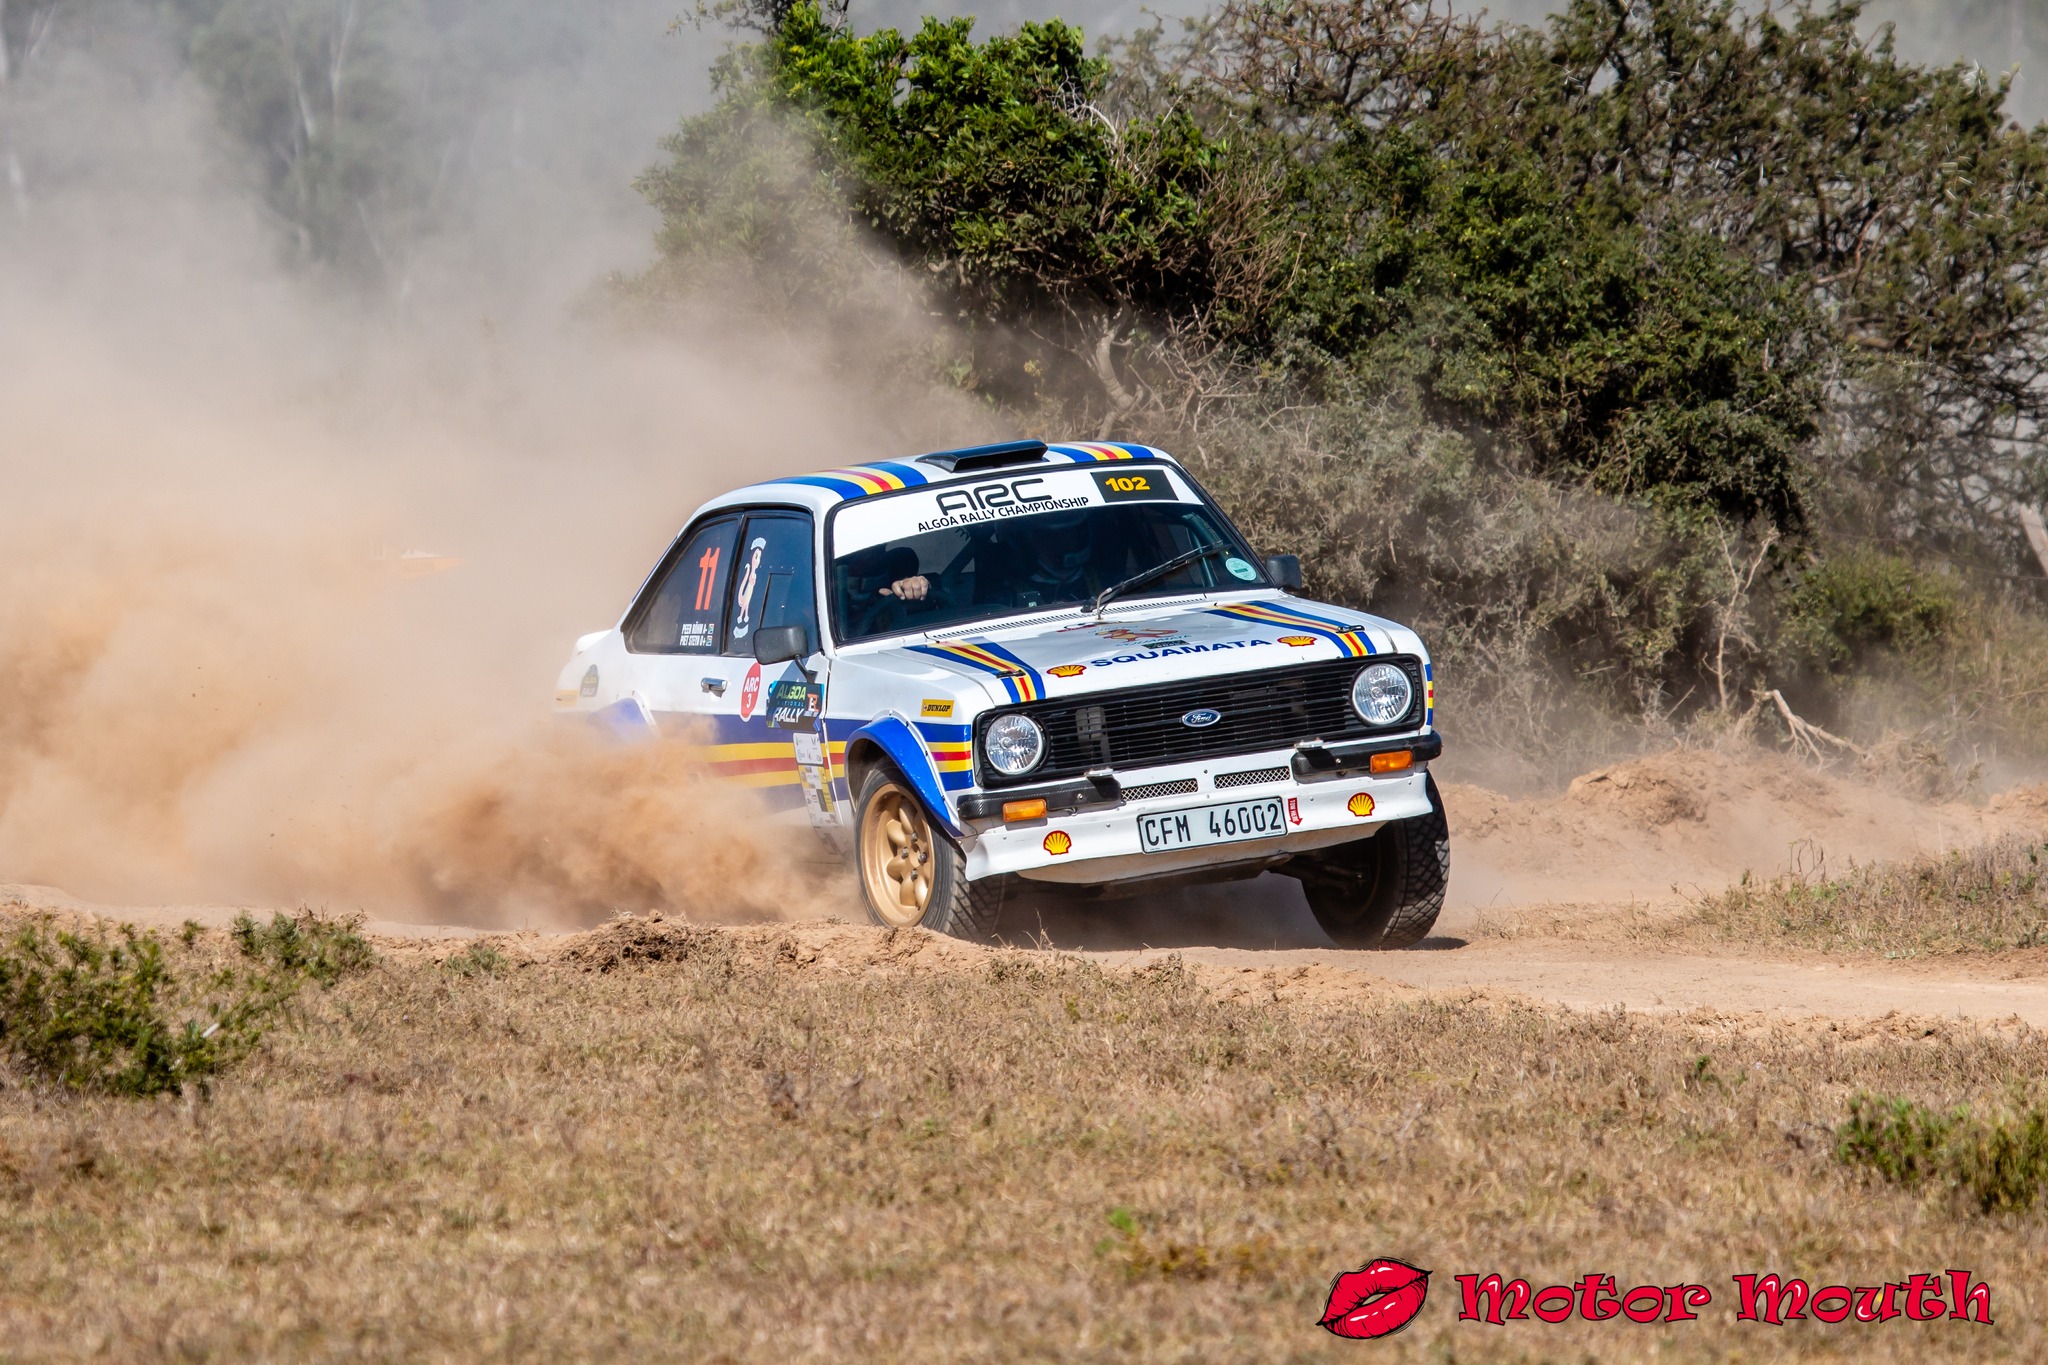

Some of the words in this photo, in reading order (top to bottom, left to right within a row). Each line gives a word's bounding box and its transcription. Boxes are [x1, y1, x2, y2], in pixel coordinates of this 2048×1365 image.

[1105, 476, 1150, 492] 102
[936, 478, 1052, 516] ARC
[918, 516, 959, 532] ALGOA
[960, 509, 996, 524] RALLY
[998, 497, 1089, 517] CHAMPIONSHIP
[695, 547, 720, 610] 11
[1090, 639, 1272, 667] SQUAMATA
[743, 676, 760, 693] ARC
[776, 684, 807, 701] ALGOA
[746, 692, 752, 708] 3
[927, 704, 951, 712] DUNLOP
[773, 706, 804, 723] RALLY
[1191, 712, 1212, 723] Ford
[1145, 815, 1191, 846] CFM
[1209, 803, 1282, 837] 46002
